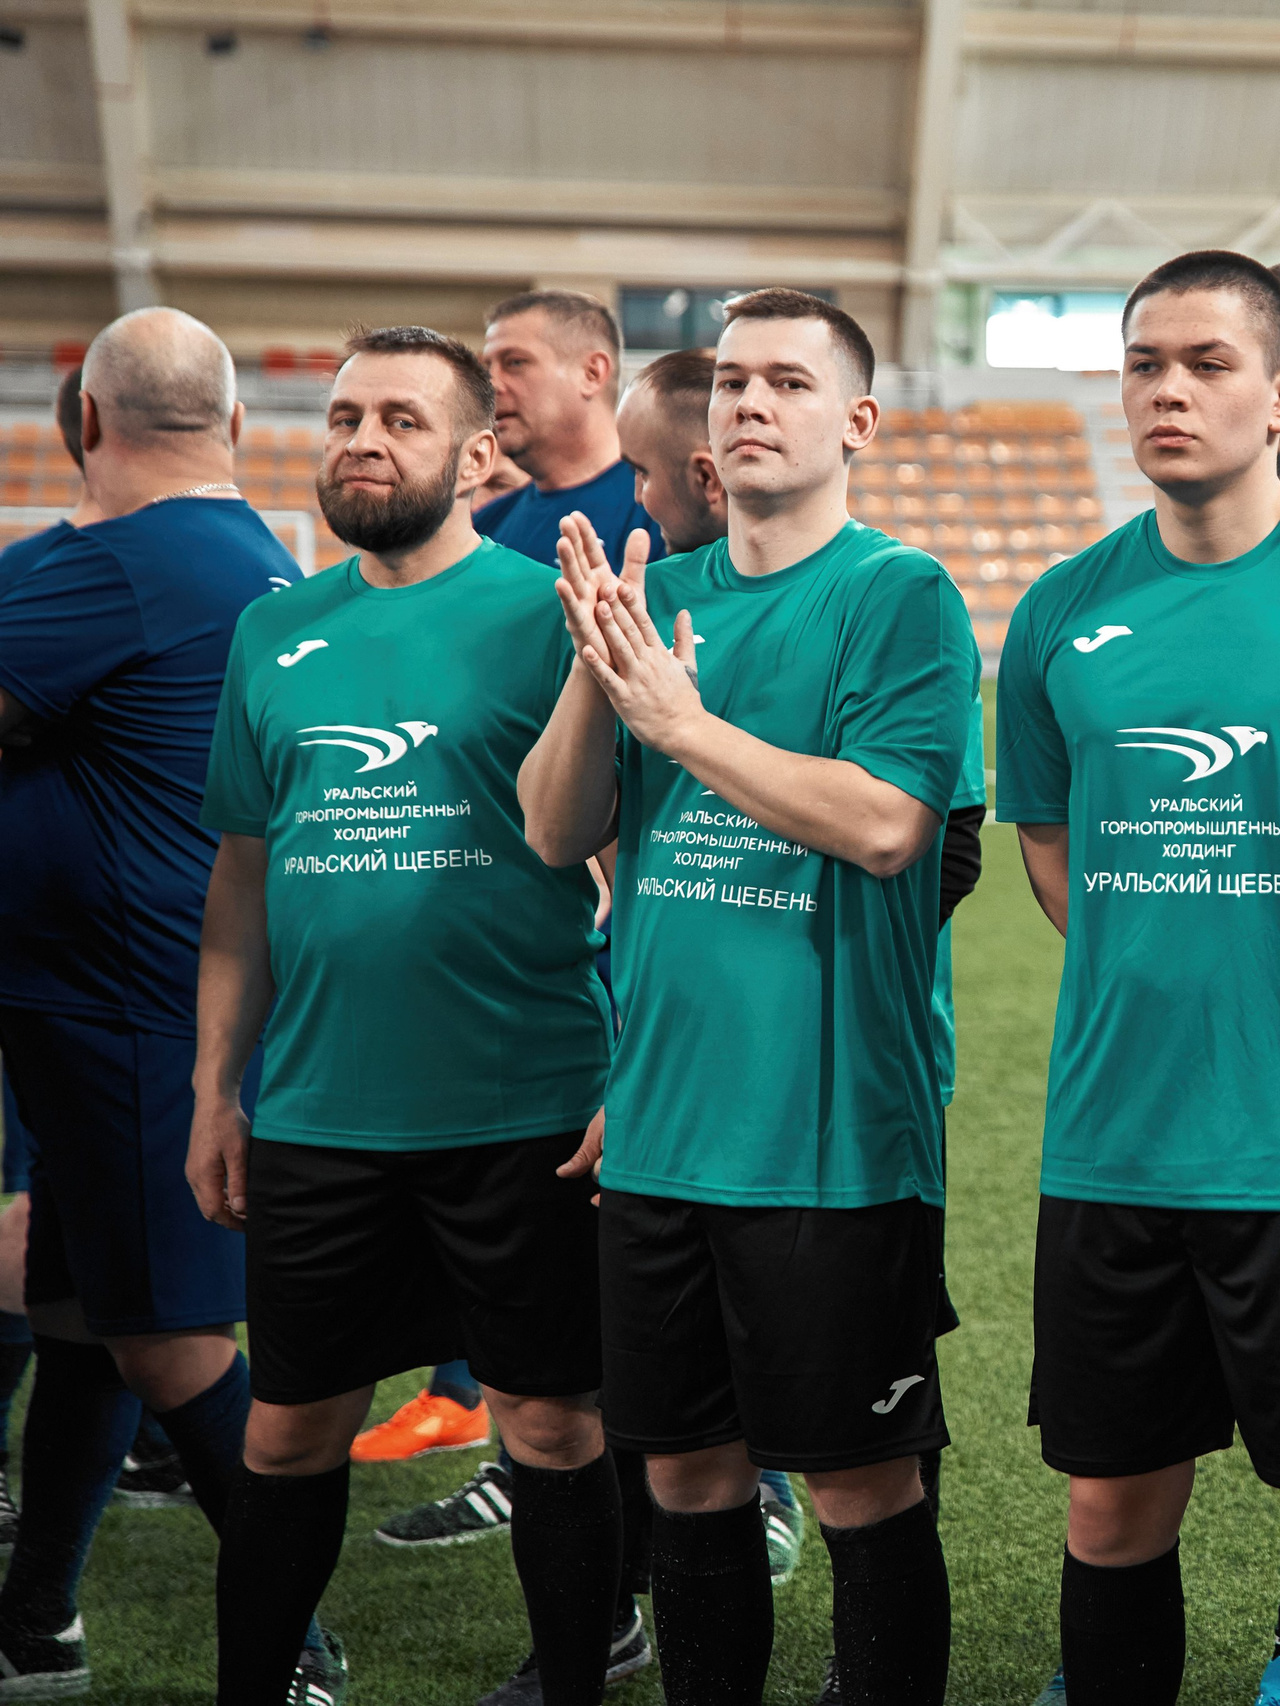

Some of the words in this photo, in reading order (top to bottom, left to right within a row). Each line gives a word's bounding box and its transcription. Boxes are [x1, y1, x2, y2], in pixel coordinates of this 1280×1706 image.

[323, 780, 417, 801] УРАЛЬСКИЙ
[295, 799, 471, 824] ГОРНОПРОМЫШЛЕННЫЙ
[1150, 794, 1243, 813] УРАЛЬСКИЙ
[333, 825, 411, 843] ХОЛДИНГ
[284, 848, 388, 875] УРАЛЬСКИЙ
[393, 848, 493, 873] ЩЕБЕНЬ
[672, 851, 744, 870] ХОЛДИНГ
[1162, 843, 1237, 860] ХОЛДИНГ
[1083, 869, 1211, 894] УРАЛЬСКИЙ
[720, 883, 818, 912] ЩЕБЕНЬ
